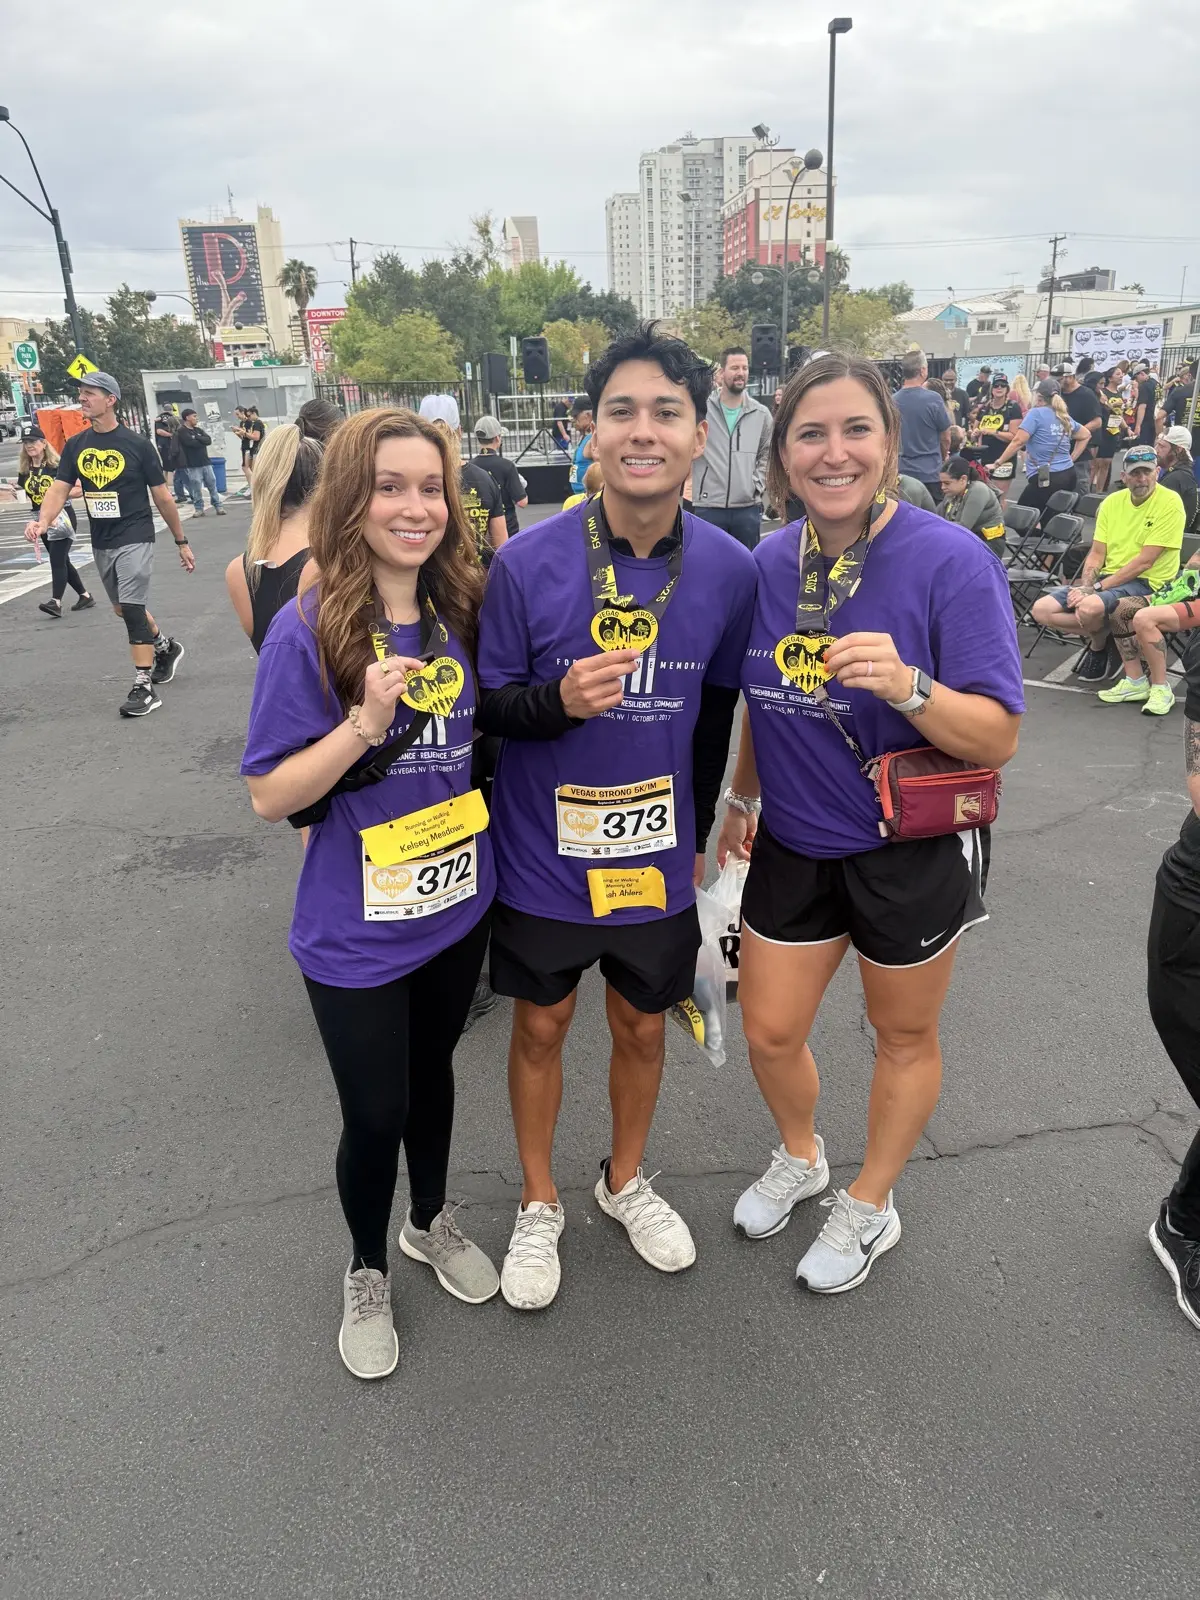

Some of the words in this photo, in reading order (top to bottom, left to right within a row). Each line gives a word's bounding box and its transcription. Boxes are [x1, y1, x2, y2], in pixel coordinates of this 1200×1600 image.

[244, 231, 255, 263] VEGAS
[202, 232, 248, 285] D
[249, 267, 258, 285] LAS
[94, 501, 117, 511] 1335
[656, 577, 677, 602] 025
[597, 610, 620, 620] VEGAS
[632, 610, 657, 626] STRONG
[782, 636, 805, 646] VEGAS
[818, 636, 837, 644] STRO
[404, 669, 421, 682] EGAS
[432, 657, 459, 670] STRONG
[620, 700, 652, 709] RESILIENCE
[654, 700, 684, 709] COMMUNITY
[749, 687, 785, 700] REMEMBRANCE
[788, 694, 818, 706] RESILIENCE
[597, 710, 616, 720] EGAS,
[617, 713, 625, 721] NV
[632, 714, 654, 722] OCTOBER
[787, 707, 796, 715] NV
[802, 709, 824, 719] OCTOBER
[386, 768, 397, 776] LAS
[571, 788, 597, 798] VEGAS
[599, 788, 632, 798] STRONG
[634, 782, 657, 794] 5K/1M
[405, 819, 427, 831] Running
[433, 810, 450, 821] Walking
[421, 823, 441, 834] Memory
[603, 804, 668, 839] 373
[400, 838, 430, 853] Kelsey
[430, 823, 465, 842] Meadows
[416, 851, 472, 896] 372
[619, 889, 643, 897] Ahlers
